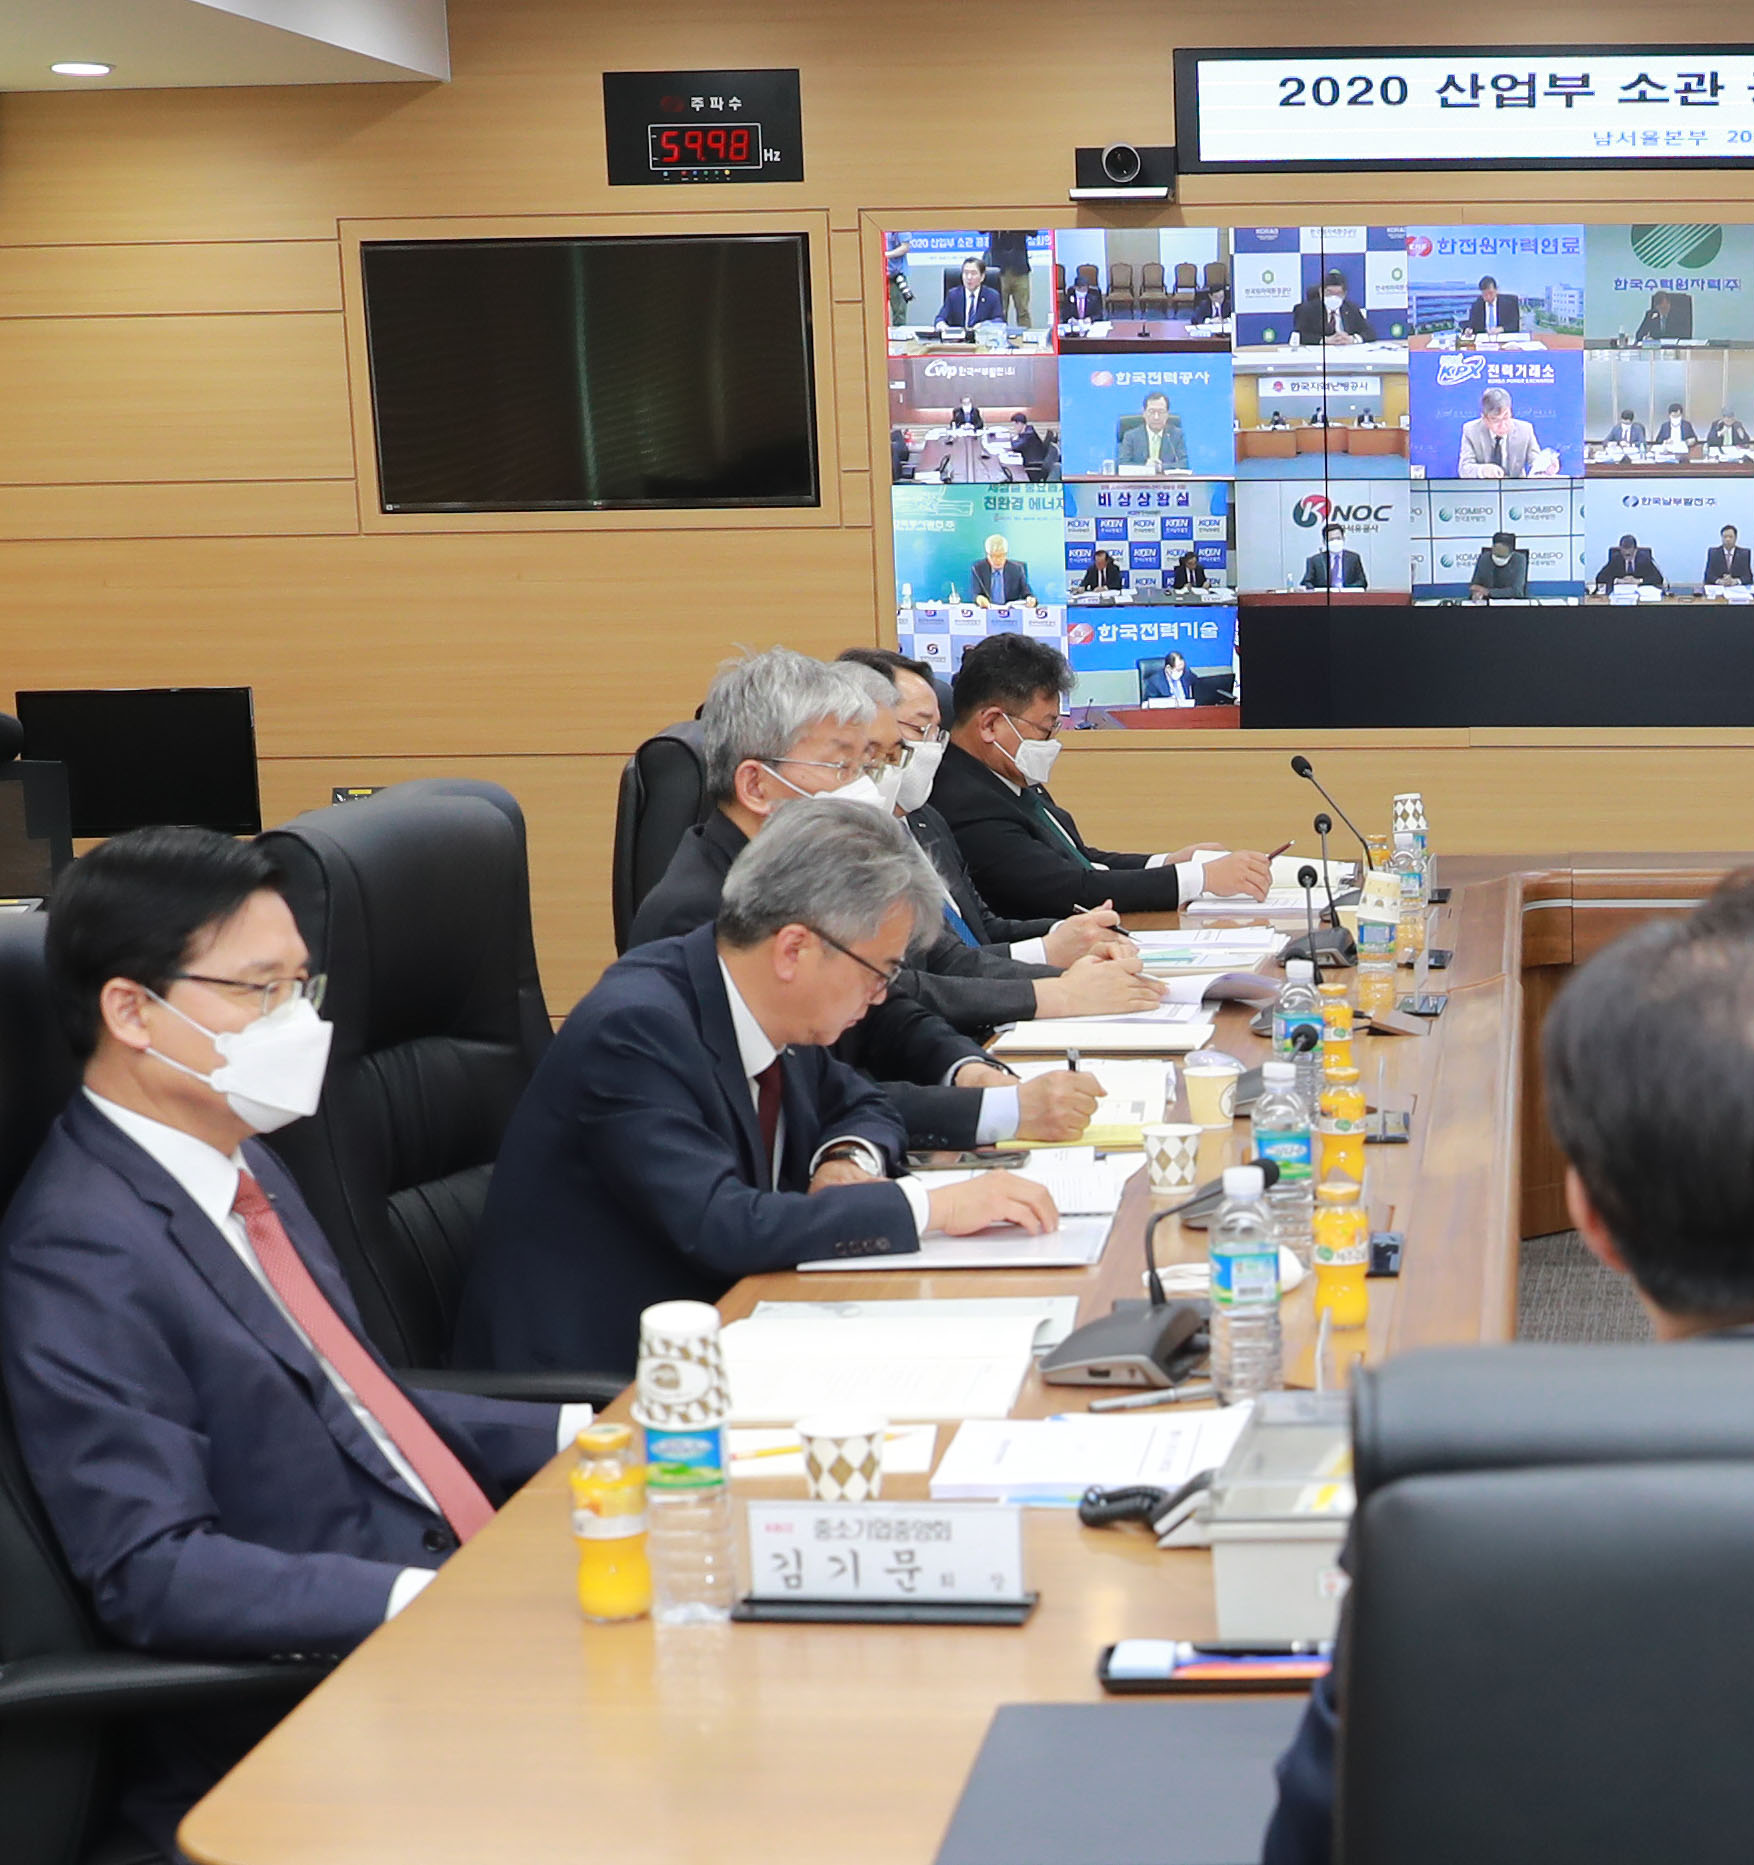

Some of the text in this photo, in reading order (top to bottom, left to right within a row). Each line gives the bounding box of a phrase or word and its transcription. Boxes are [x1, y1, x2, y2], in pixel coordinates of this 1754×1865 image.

[1278, 75, 1410, 107] 2020
[1434, 71, 1596, 109] 산업부
[1617, 71, 1727, 108] 소관
[763, 148, 781, 163] Hz
[1437, 236, 1581, 256] 한전원자력연료
[1115, 370, 1211, 386] 한국전력공사
[1487, 363, 1555, 378] 전력거래소
[1454, 507, 1494, 516] KOMIPO
[1524, 505, 1564, 514] KOMIPO
[1097, 621, 1219, 642] 한국전력기술
